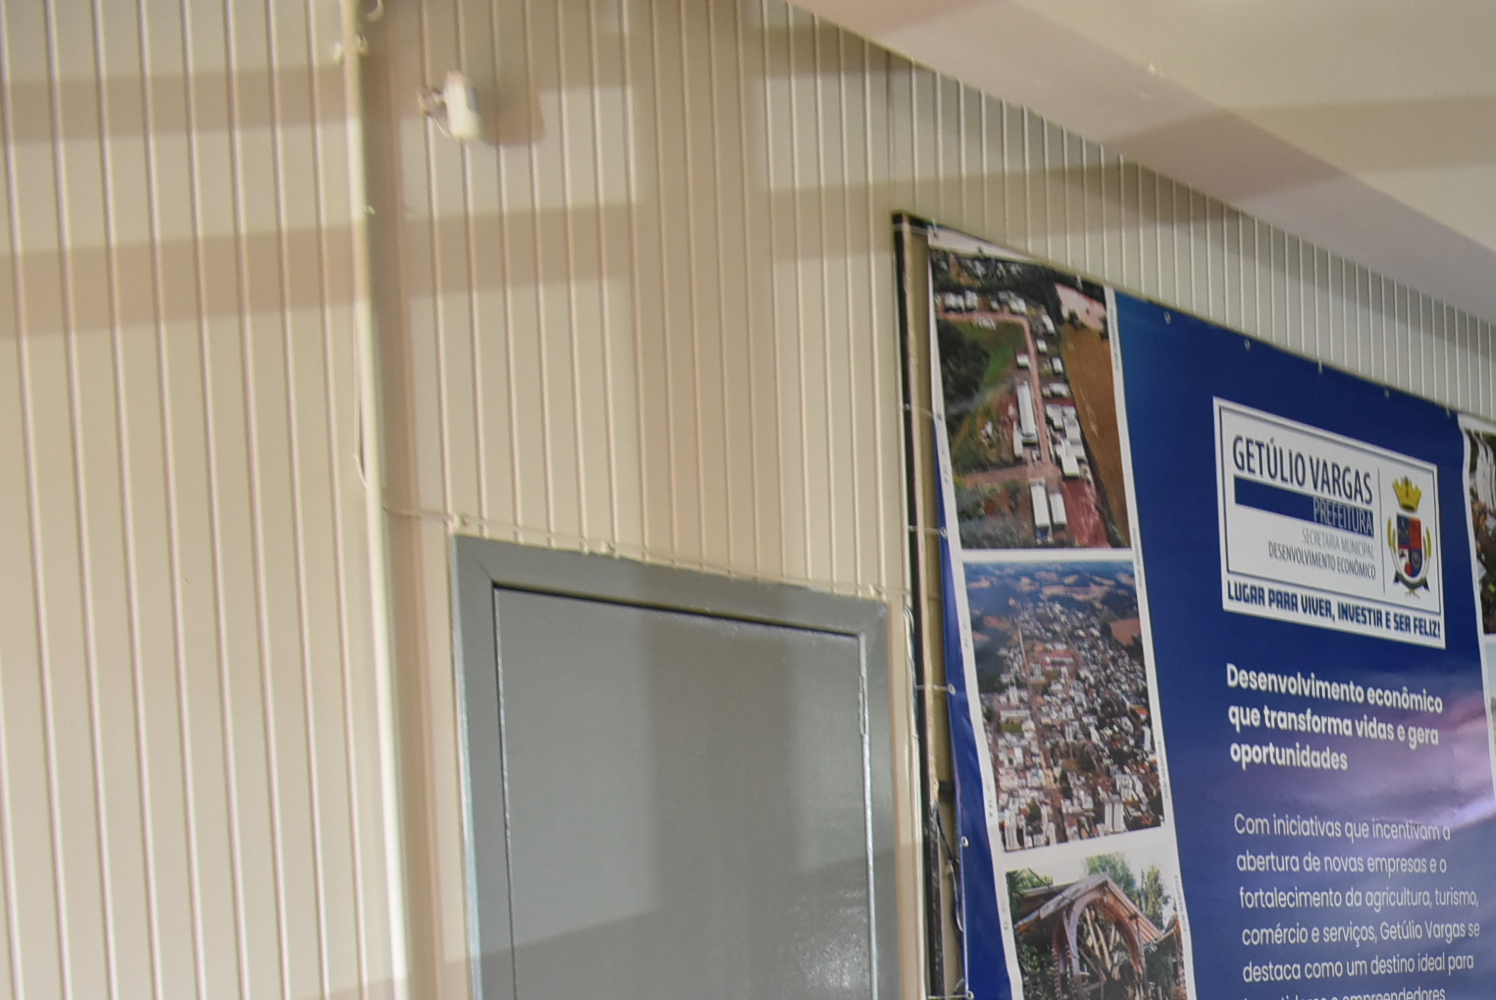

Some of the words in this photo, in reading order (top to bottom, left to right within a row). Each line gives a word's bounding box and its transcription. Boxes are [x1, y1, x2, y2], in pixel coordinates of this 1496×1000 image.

[1233, 435, 1306, 486] GETÚLIO
[1309, 456, 1373, 505] VARGAS
[1313, 497, 1374, 535] PREFEITURA
[1302, 527, 1339, 549] SECRETARIA
[1341, 537, 1375, 559] MUNICIPAL
[1268, 541, 1335, 571] DESENVOLVIMENTO
[1337, 555, 1376, 580] ECONÔMICO
[1227, 580, 1266, 606] LUGAR
[1269, 589, 1298, 612] PARA
[1301, 595, 1335, 622] VIVER,
[1338, 602, 1383, 628] INVESTIR
[1386, 612, 1392, 629] E
[1394, 614, 1411, 632] SER
[1413, 617, 1441, 638] FELIZ!
[1226, 663, 1364, 703] Desenvolvimento
[1367, 686, 1443, 714] econômico
[1228, 704, 1261, 731] que
[1264, 705, 1352, 736] transforma
[1355, 715, 1394, 740] vidas
[1397, 727, 1405, 742] e
[1408, 727, 1439, 750] gera
[1230, 742, 1348, 770] oportunidades
[1234, 813, 1270, 835] Com
[1273, 814, 1341, 838] iniciativas
[1345, 822, 1369, 843] que
[1372, 817, 1440, 841] incentivam
[1443, 825, 1451, 841] a
[1237, 849, 1300, 872] abertura
[1303, 852, 1321, 872] de
[1324, 856, 1364, 873] novas
[1367, 856, 1427, 878] empresas
[1430, 857, 1437, 873] e
[1439, 857, 1447, 873] o
[1239, 886, 1342, 909] fortalecimento
[1345, 887, 1362, 907] da
[1365, 887, 1433, 912] agricultura,
[1435, 887, 1479, 908] turismo,
[1242, 922, 1308, 945] comércio
[1311, 926, 1320, 942] e
[1323, 922, 1378, 947] serviços,
[1380, 920, 1423, 941] Getúlio
[1424, 920, 1465, 944] Vargas
[1468, 921, 1480, 938] se
[1243, 959, 1301, 982] destaca
[1304, 960, 1343, 979] como
[1346, 959, 1368, 976] um
[1370, 955, 1415, 975] destino
[1418, 952, 1445, 972] ideal
[1448, 953, 1474, 975] para
